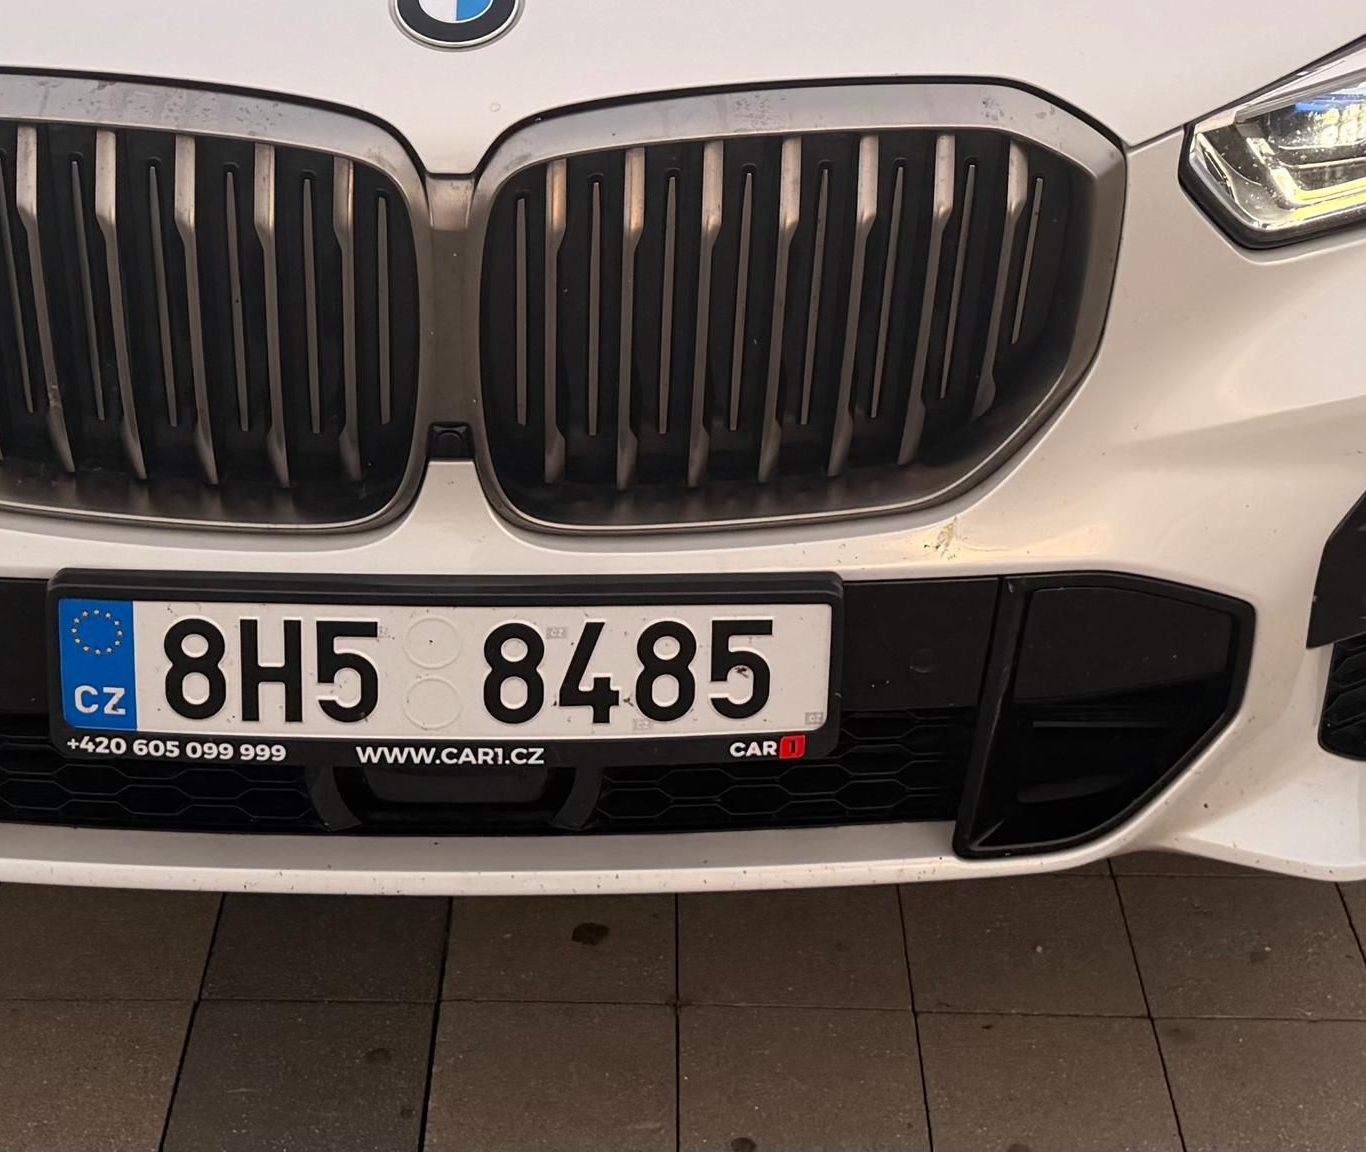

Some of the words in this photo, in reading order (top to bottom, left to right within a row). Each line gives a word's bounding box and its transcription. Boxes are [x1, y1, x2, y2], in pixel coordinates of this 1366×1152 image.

[164, 618, 378, 723] 8H5
[483, 619, 773, 725] 8485
[74, 686, 126, 716] CZ
[67, 736, 127, 754] +420
[133, 739, 180, 757] 605
[185, 742, 234, 759] 099
[240, 744, 286, 761] 999
[355, 746, 545, 765] WWW.CAR1.CZ
